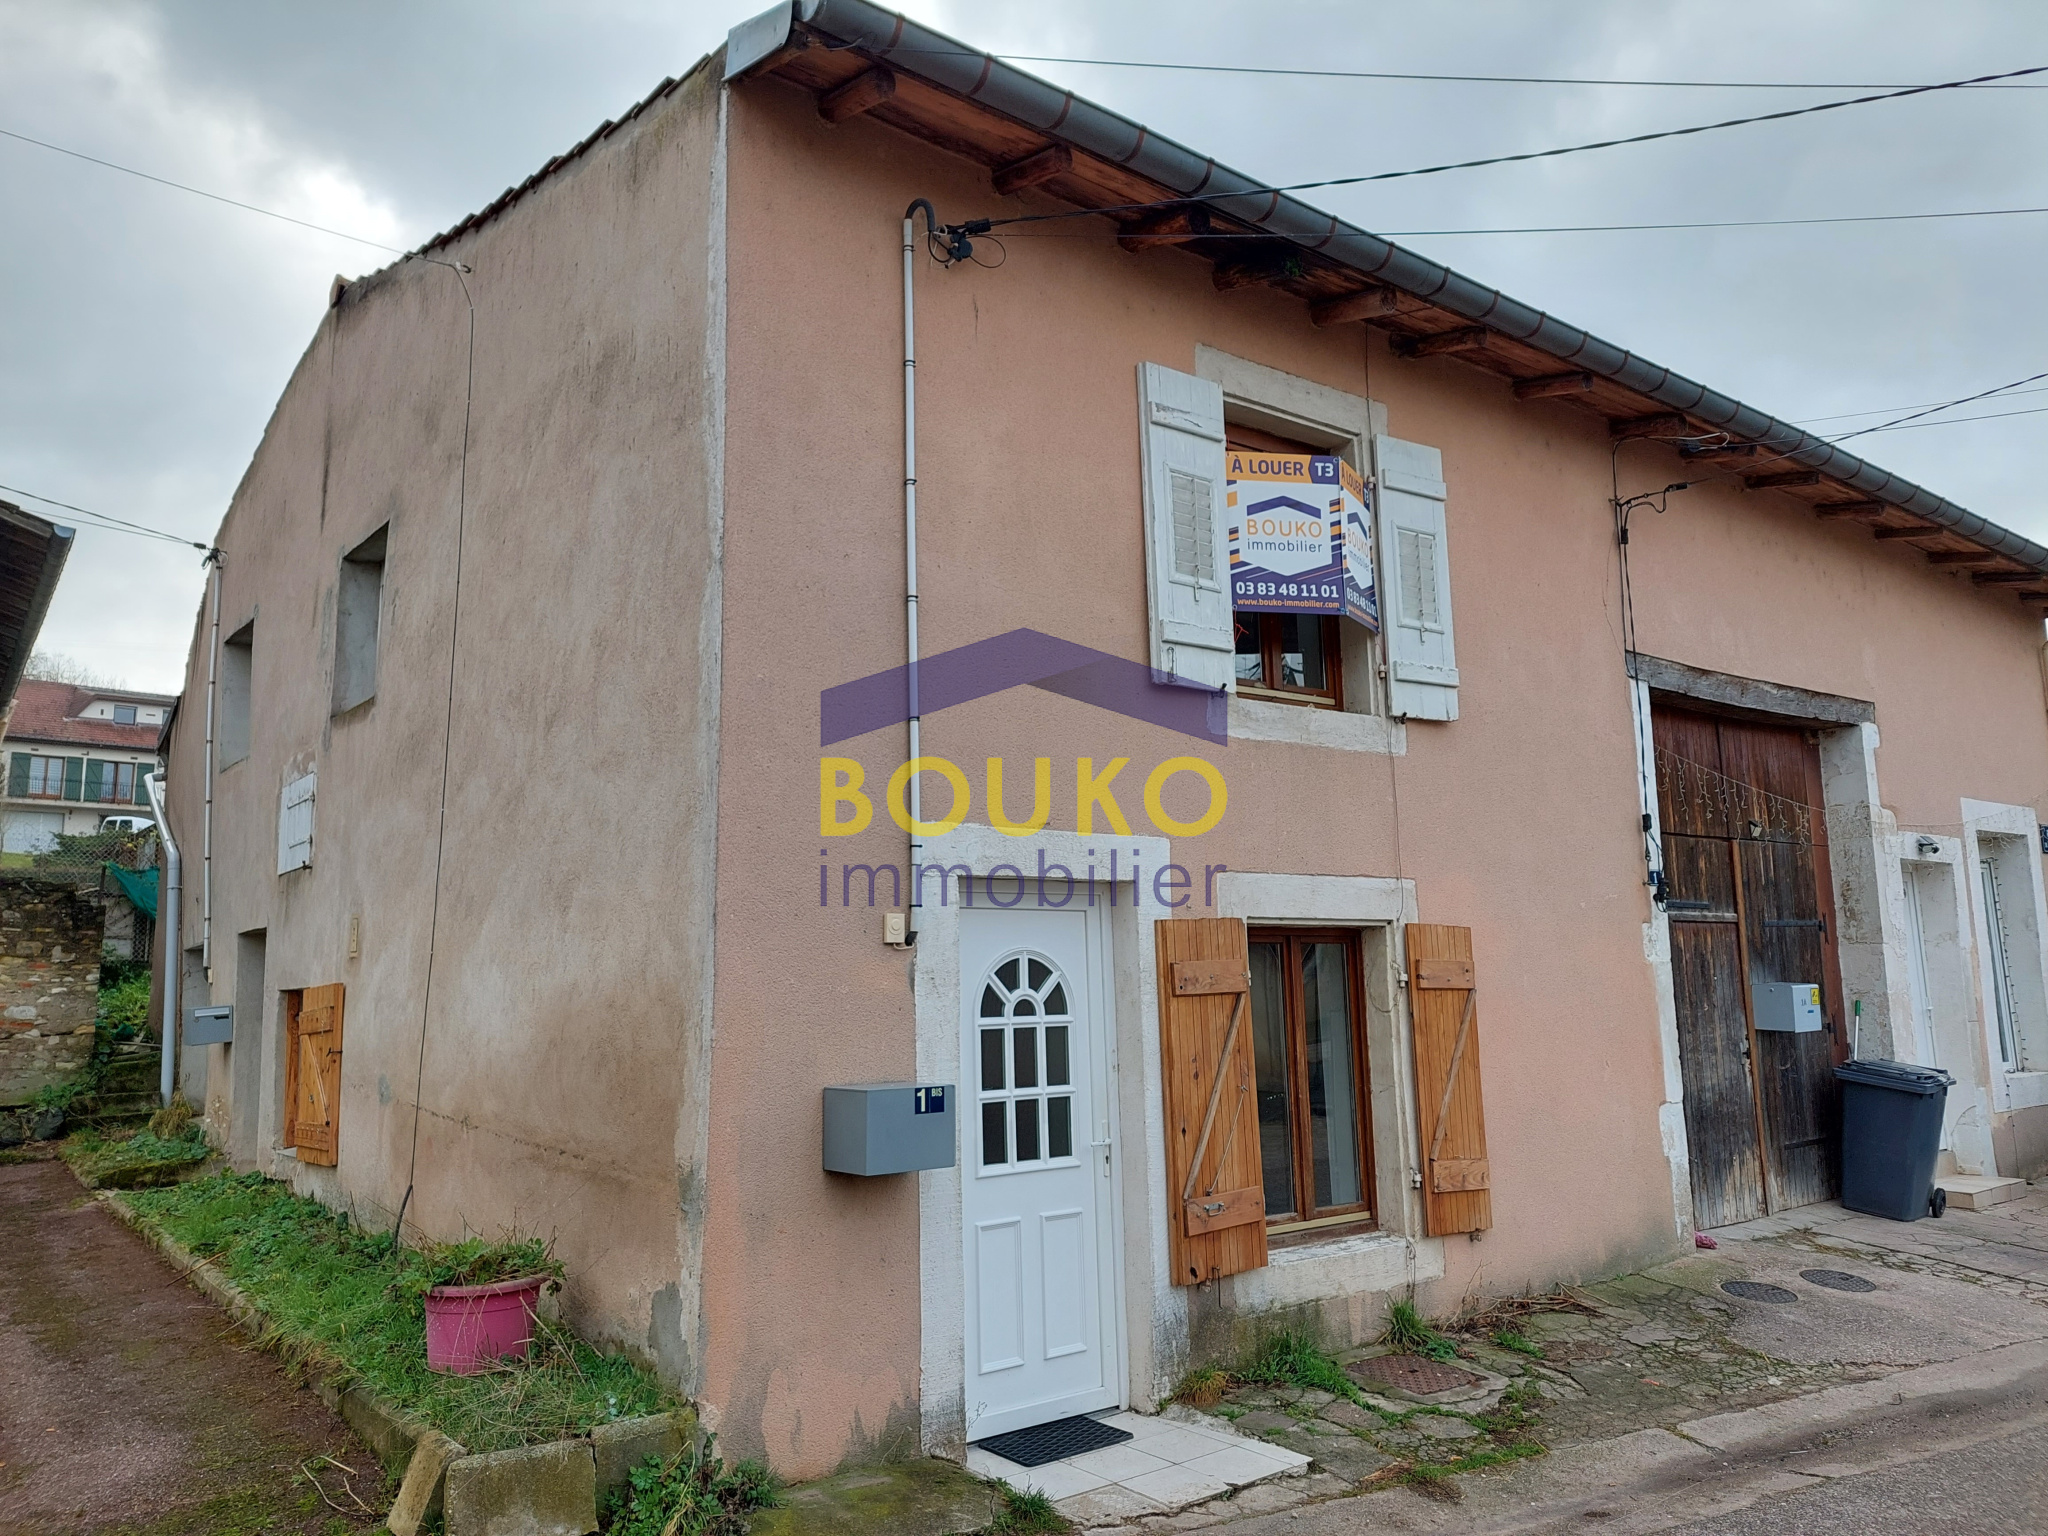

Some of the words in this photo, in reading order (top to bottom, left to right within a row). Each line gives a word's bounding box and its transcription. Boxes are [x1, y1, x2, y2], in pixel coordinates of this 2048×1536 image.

[1231, 454, 1244, 474] À
[1249, 459, 1304, 477] LOUER
[1314, 462, 1335, 477] T3
[1246, 518, 1323, 538] BOUKO
[1247, 538, 1323, 553] immobilier
[1235, 581, 1255, 595] 03
[1257, 582, 1276, 596] 83
[1278, 583, 1298, 596] 48
[1300, 584, 1319, 597] 11
[1320, 585, 1339, 598] 01
[1237, 599, 1340, 609] www.bouko-immobilier.com
[917, 1088, 926, 1112] 1
[931, 1087, 943, 1097] BIS
